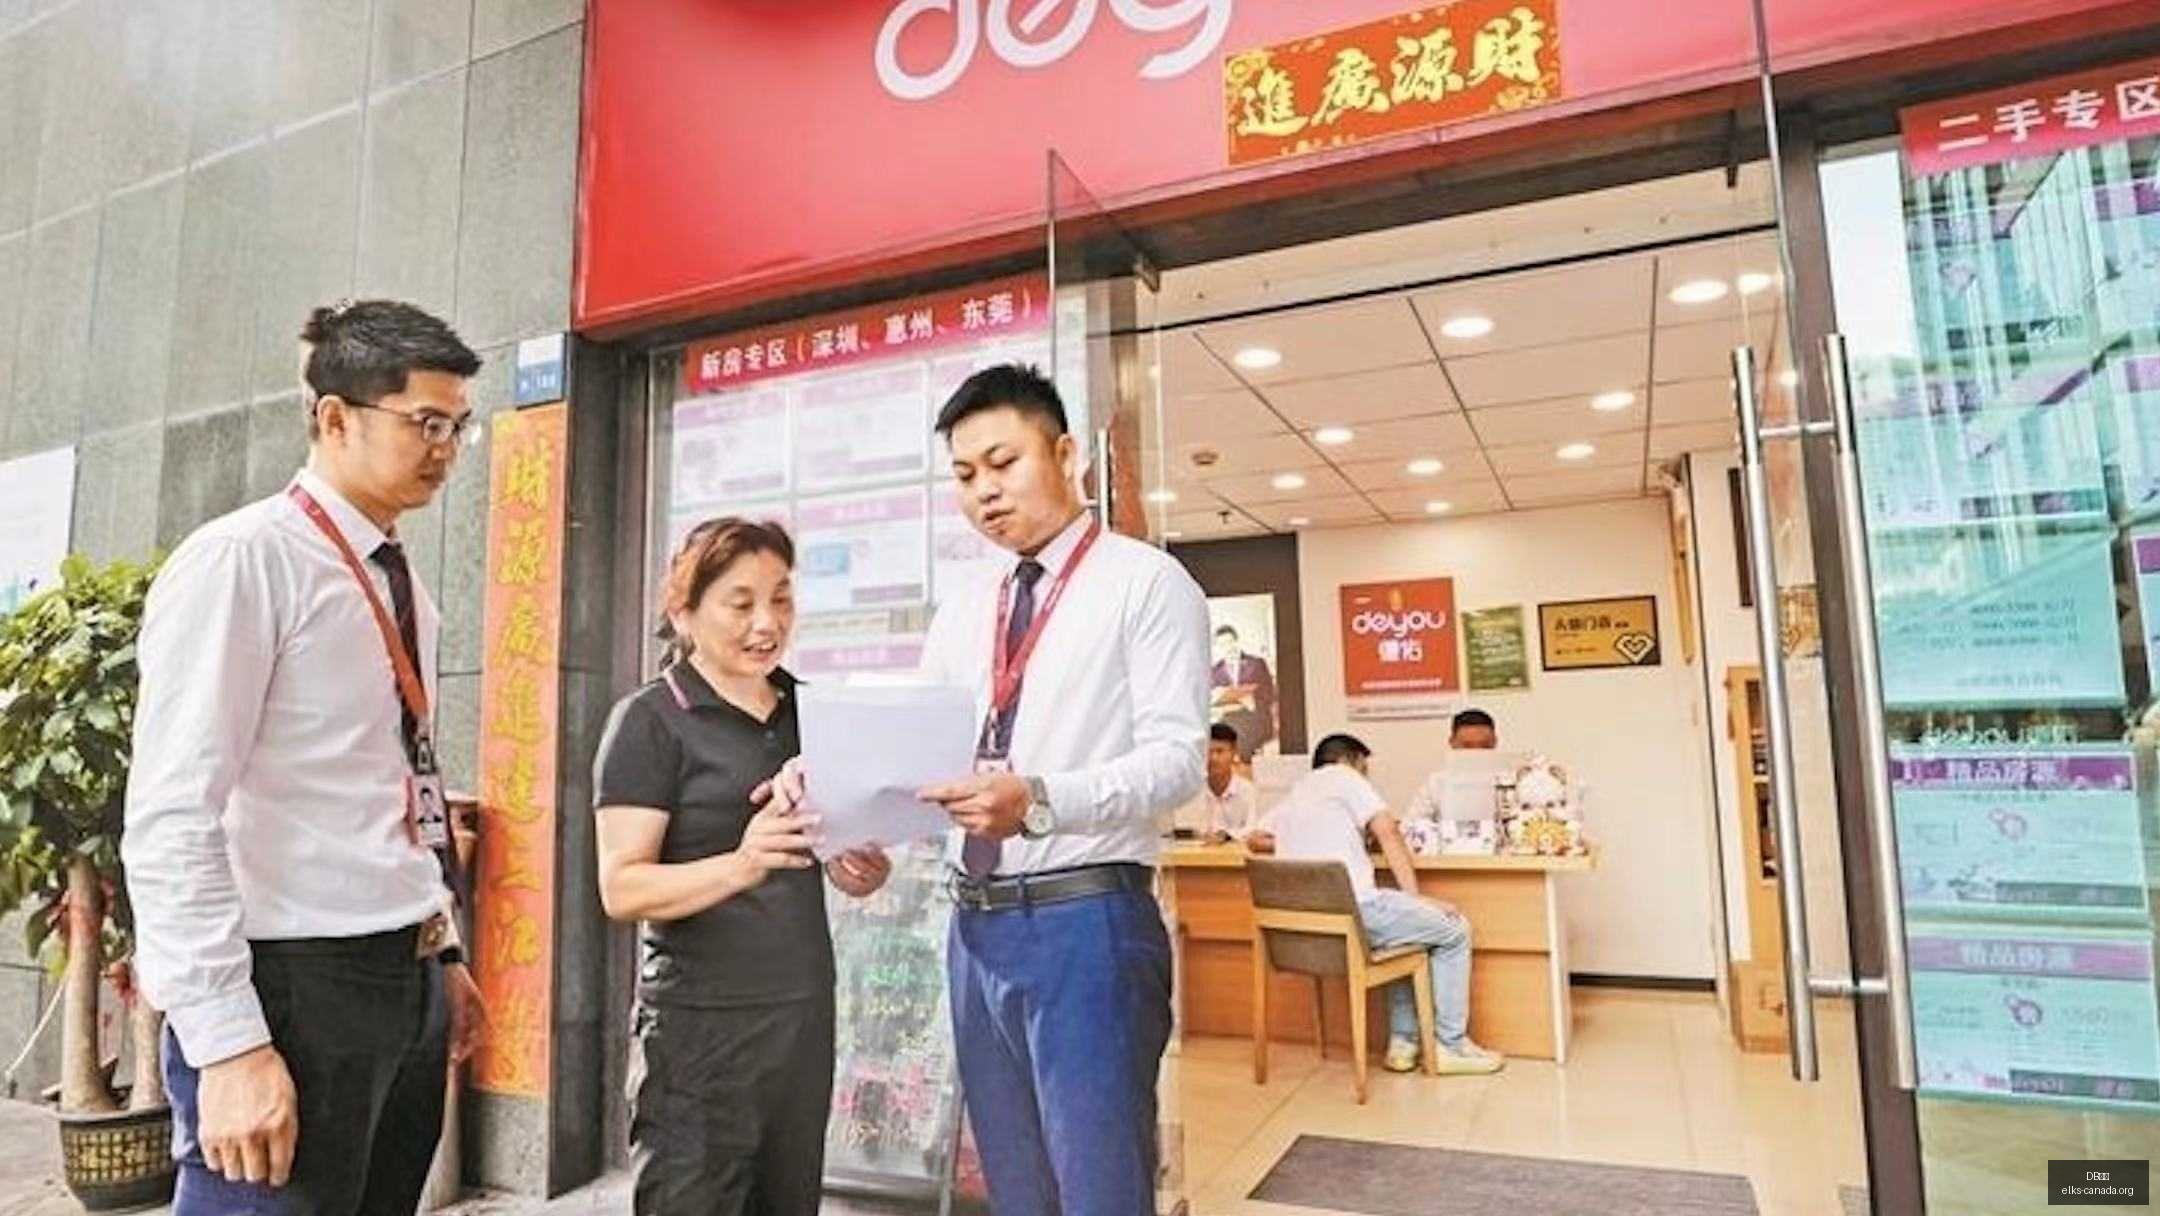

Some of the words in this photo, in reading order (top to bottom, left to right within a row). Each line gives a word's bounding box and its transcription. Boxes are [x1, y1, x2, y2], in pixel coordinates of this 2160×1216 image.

[1938, 75, 2160, 152] 二手专区
[1351, 609, 1446, 638] deyou
